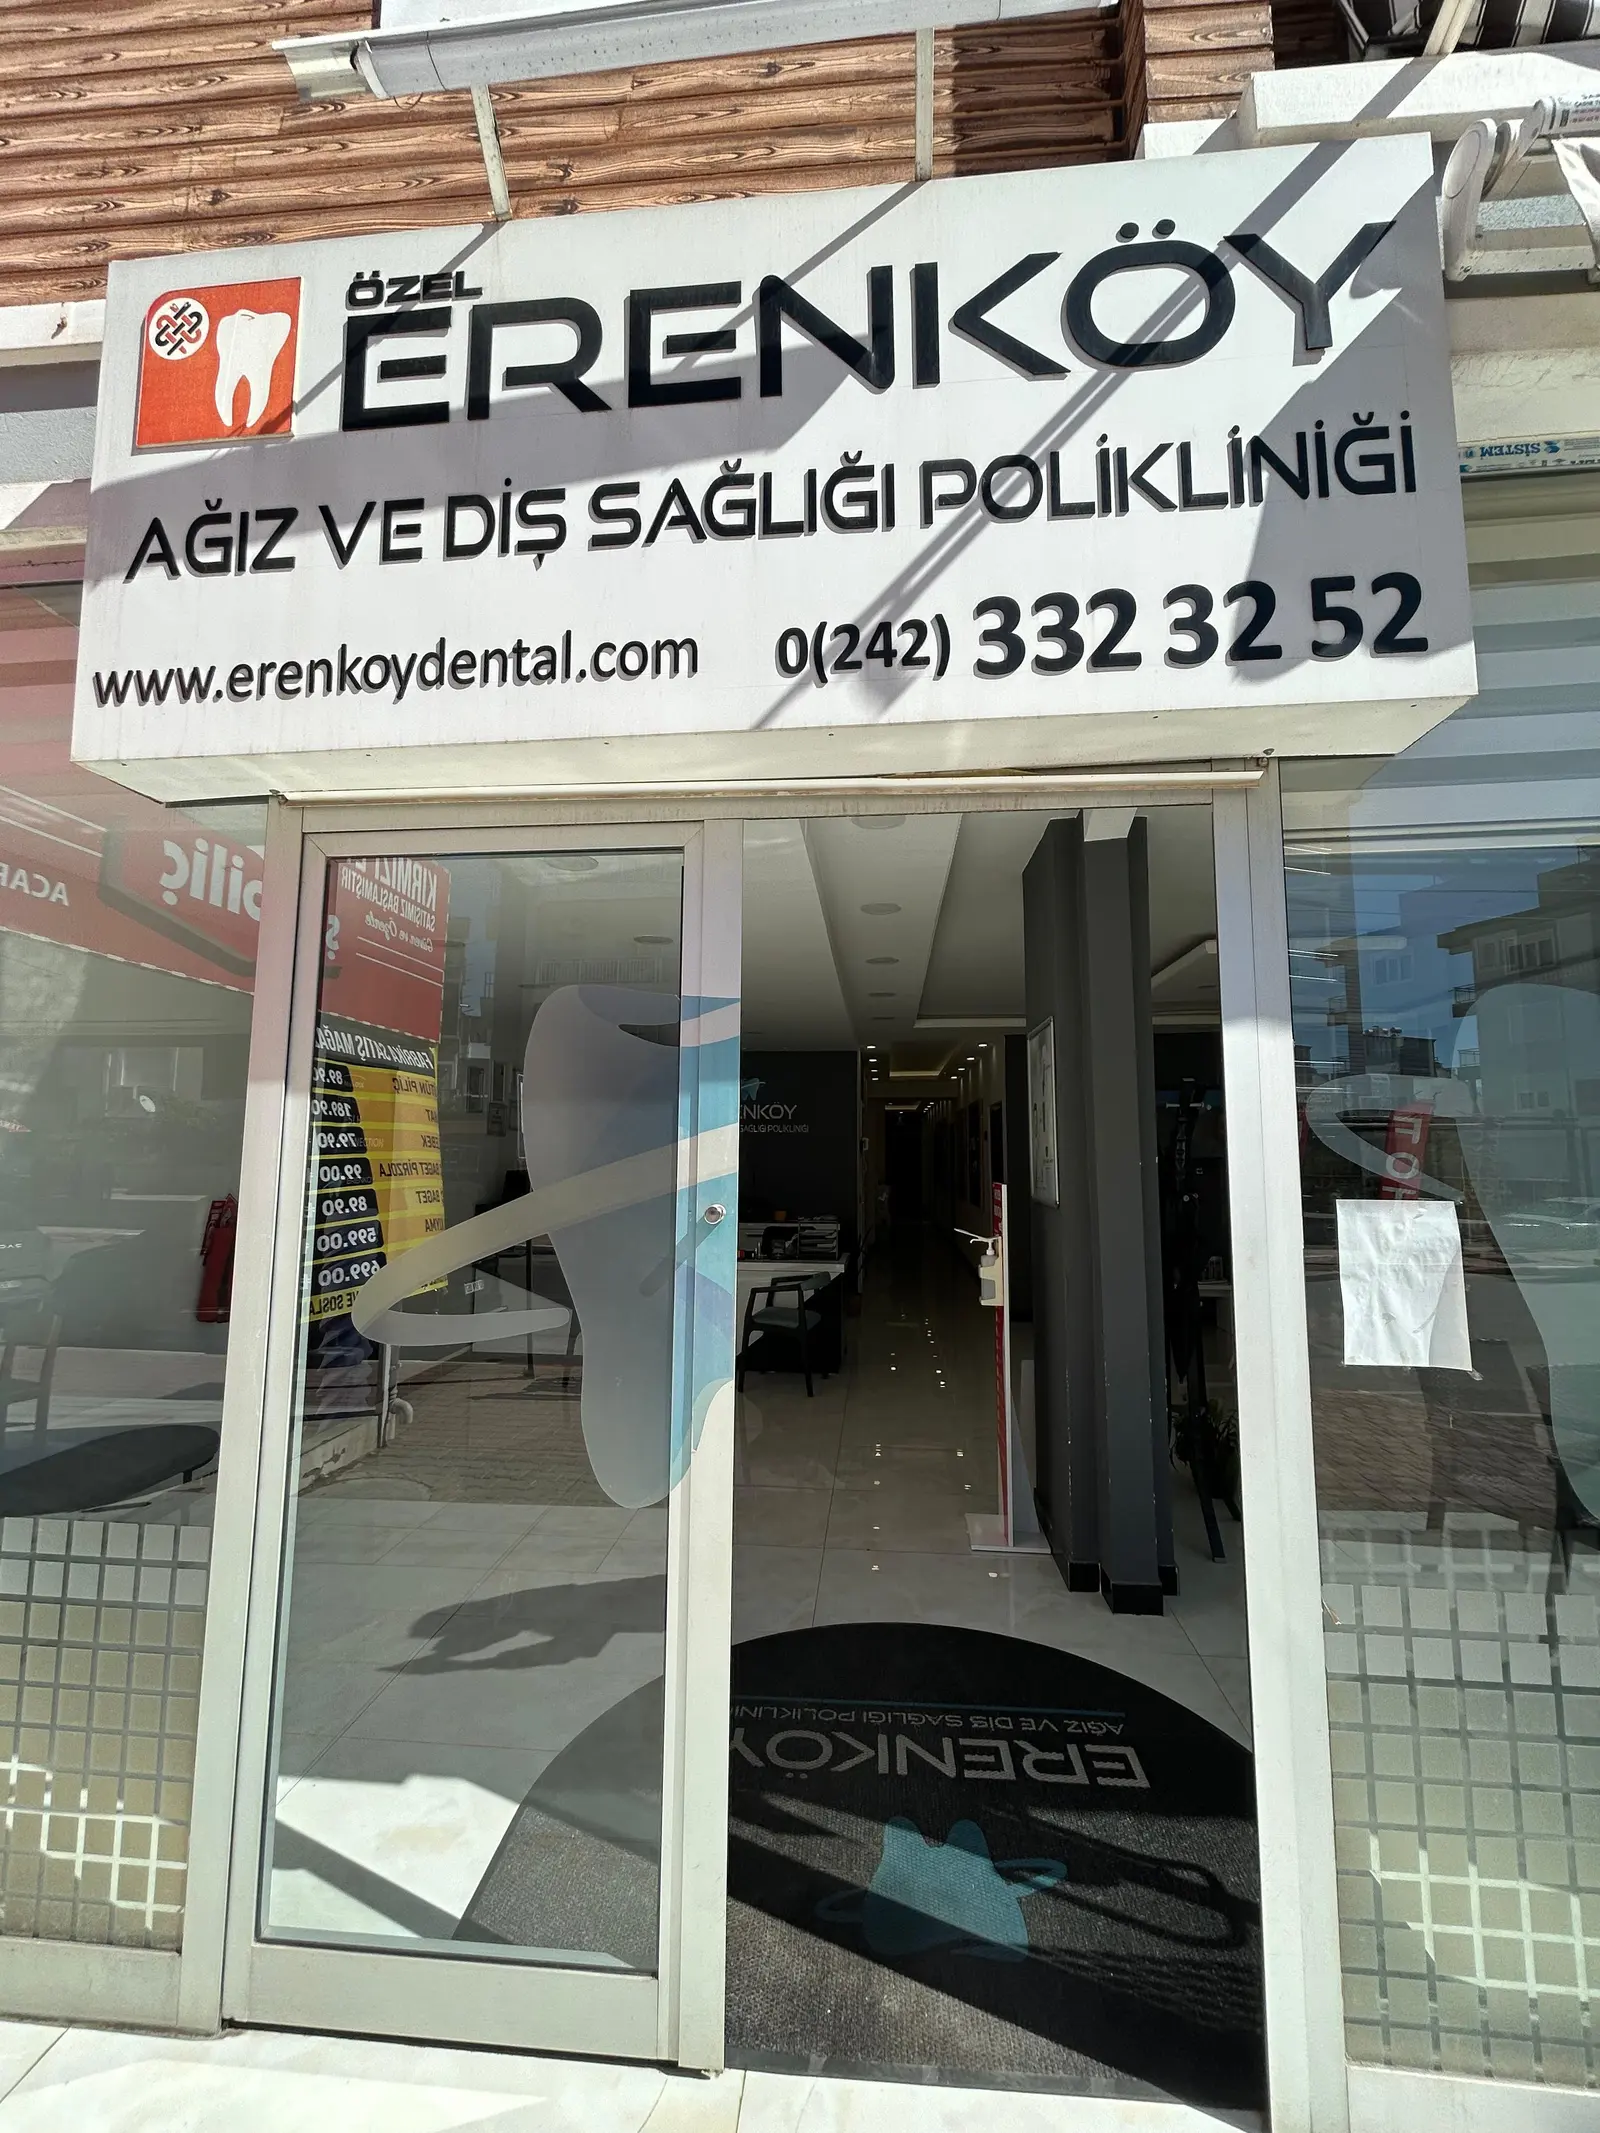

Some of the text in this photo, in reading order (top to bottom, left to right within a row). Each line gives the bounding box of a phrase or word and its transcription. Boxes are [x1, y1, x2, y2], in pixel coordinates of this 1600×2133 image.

[342, 218, 1396, 431] ERENKÖY
[346, 271, 482, 308] ÖZEL
[125, 409, 1416, 582] AĞIZ VE DİŞ SAĞLIĞI POLİKLİNİĞİ
[94, 630, 698, 707] www.erenkoydental.com
[777, 571, 1428, 685] 0(242) 332 32 52
[740, 1101, 798, 1120] NKÖY
